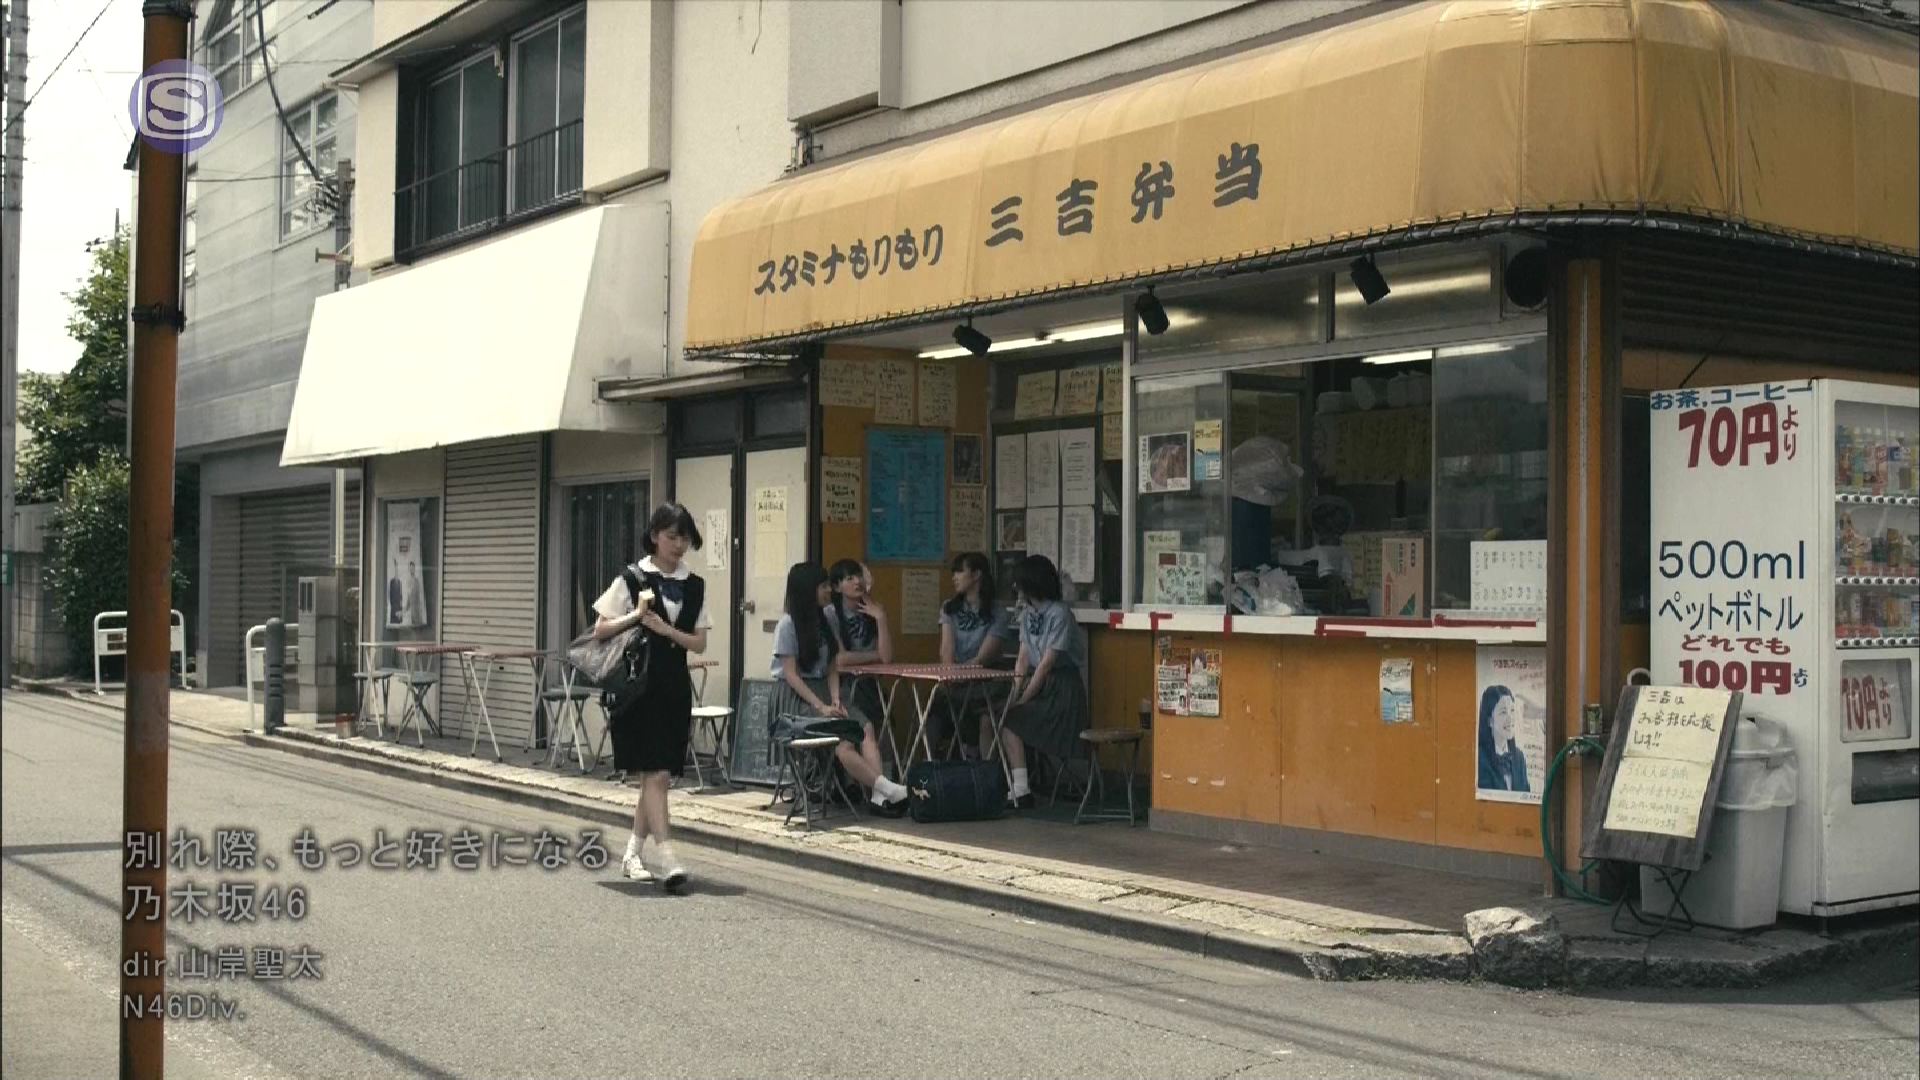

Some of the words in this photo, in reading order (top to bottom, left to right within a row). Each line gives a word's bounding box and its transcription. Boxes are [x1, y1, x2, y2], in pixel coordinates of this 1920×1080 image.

[755, 224, 943, 295] スタミナもりもり
[985, 142, 1263, 247] 三吉弁当
[1679, 402, 1779, 468] 70円
[1782, 404, 1799, 461] より
[1659, 540, 1805, 580] 500ml
[1658, 590, 1804, 632] ペットボトル
[1680, 634, 1791, 656] どれでも
[1679, 660, 1792, 696] 100円
